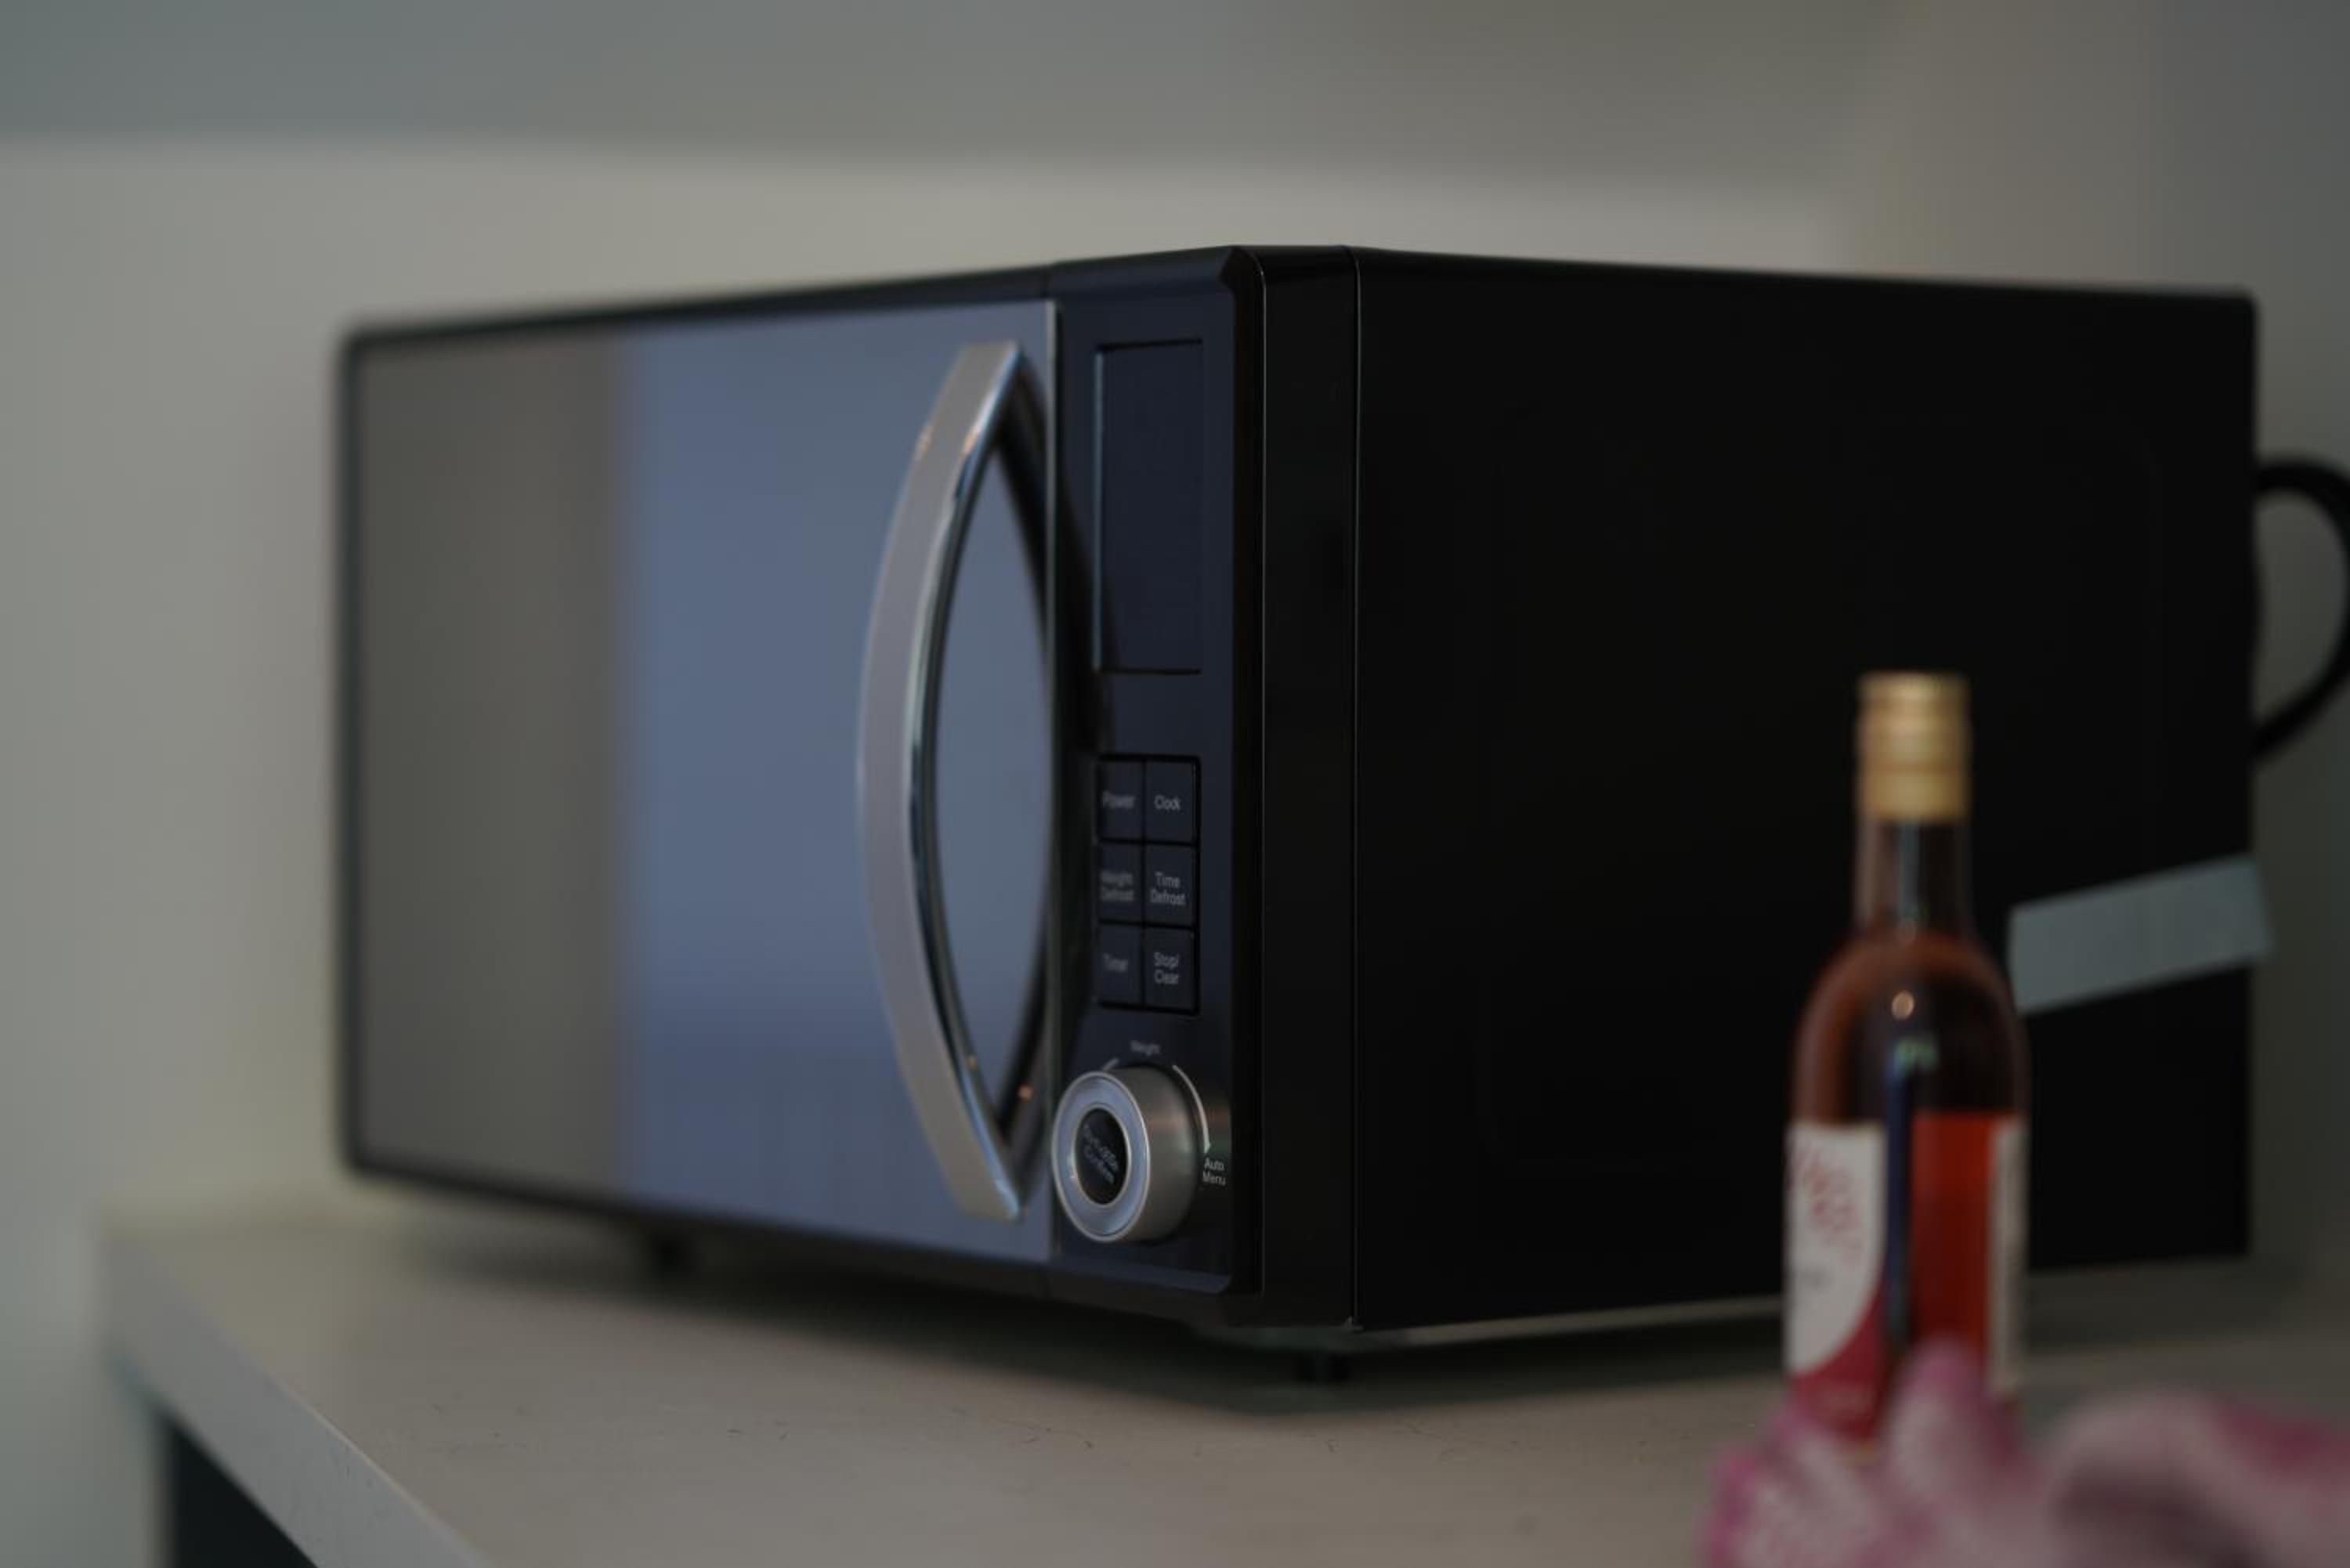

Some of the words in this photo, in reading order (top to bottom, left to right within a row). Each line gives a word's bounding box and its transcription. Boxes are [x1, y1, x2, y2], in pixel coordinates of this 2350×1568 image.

[1154, 794, 1181, 811] Clock
[1155, 871, 1180, 888] Time
[1150, 888, 1187, 905] Defrost
[1154, 970, 1179, 985] Clear
[1204, 1157, 1224, 1171] Auto
[1202, 1170, 1226, 1187] Menu
